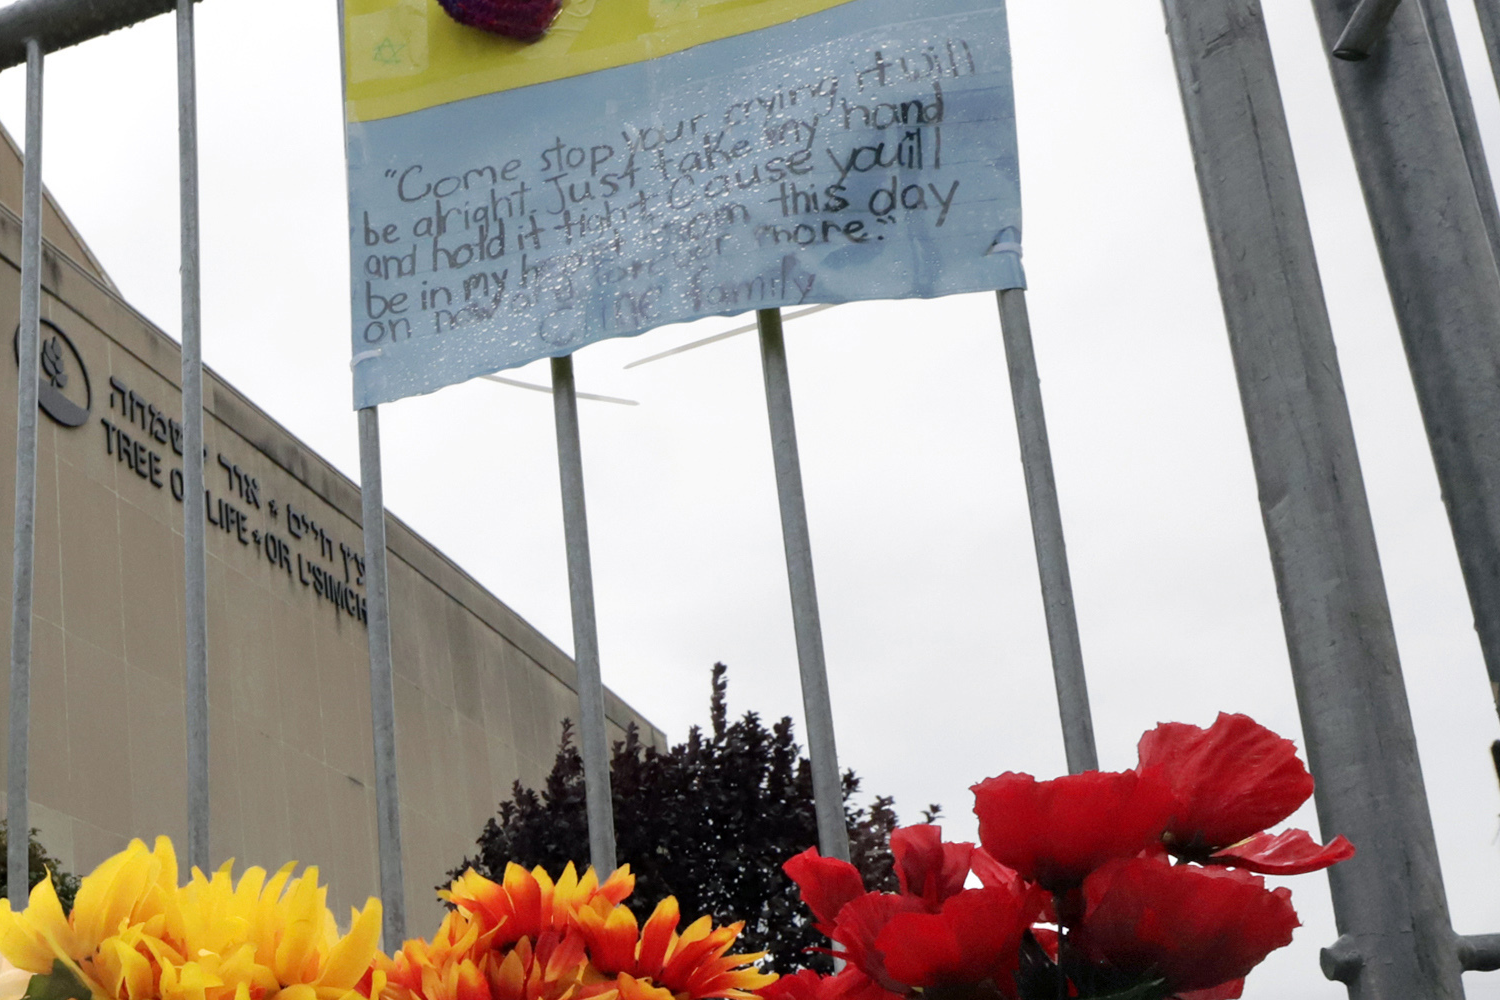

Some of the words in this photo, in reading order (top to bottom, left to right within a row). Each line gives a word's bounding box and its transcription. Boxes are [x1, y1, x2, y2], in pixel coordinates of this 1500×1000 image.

[362, 210, 400, 247] be
[541, 154, 640, 215] Just
[658, 131, 751, 182] take
[839, 80, 944, 131] hand
[539, 136, 615, 178] stop
[363, 244, 417, 281] and
[432, 218, 505, 273] hold
[517, 214, 546, 251] it
[364, 281, 411, 321] be
[420, 280, 452, 312] in
[462, 268, 509, 315] my
[767, 180, 853, 218] this
[867, 174, 961, 228] day
[691, 254, 817, 312] family
[362, 315, 413, 344] on
[108, 375, 206, 464] שמחה
[101, 417, 164, 489] TREE
[169, 467, 185, 504] O
[204, 489, 250, 547] LIFE
[263, 531, 293, 575] OR
[297, 552, 368, 630] L'SIMCH
